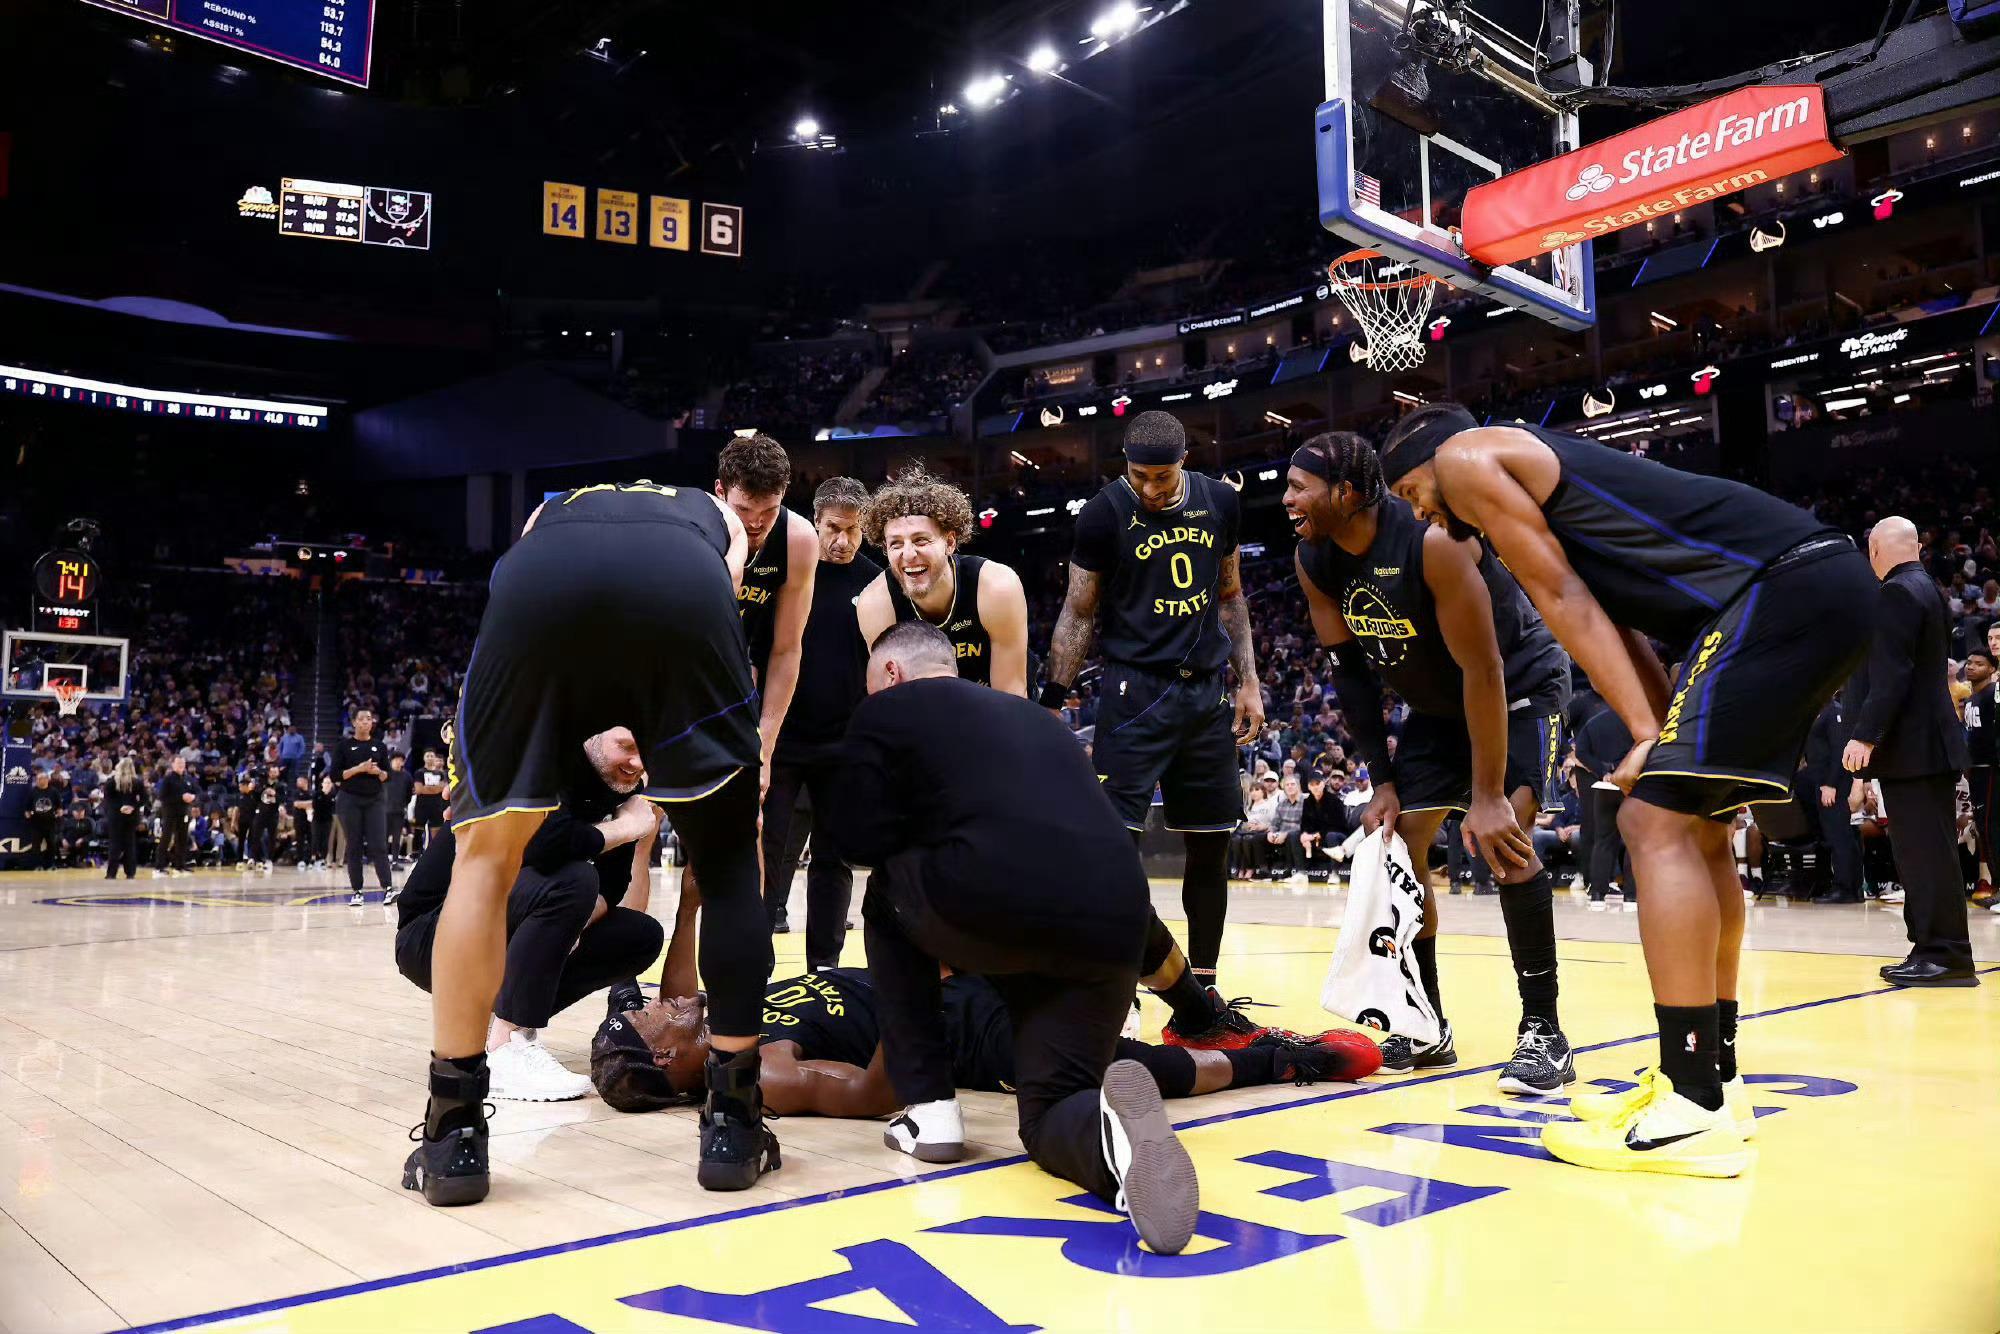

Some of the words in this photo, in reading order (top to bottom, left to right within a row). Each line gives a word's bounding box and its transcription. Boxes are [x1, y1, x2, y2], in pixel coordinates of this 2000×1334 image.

[203, 2, 247, 21] REBOUND
[203, 18, 234, 33] ASSIST
[320, 21, 344, 37] 113.7
[550, 202, 577, 231] 14
[603, 208, 631, 237] 13
[662, 217, 677, 242] 9
[710, 214, 733, 245] 6
[1219, 315, 1241, 325] CENTER
[1859, 328, 1909, 350] Sports
[1771, 355, 1808, 368] PRESENTED
[1808, 353, 1819, 361] BY
[1850, 348, 1868, 360] BAY
[1869, 342, 1898, 355] AREA
[1135, 526, 1215, 560] GOLDEN
[57, 561, 88, 576] 7:41
[1170, 552, 1193, 589] 0
[1373, 567, 1400, 577] Rakuten
[59, 576, 84, 600] 14
[736, 585, 771, 605] DEN
[53, 607, 90, 617] TISSOT
[1153, 588, 1209, 617] STATE
[798, 974, 845, 1017] STATE
